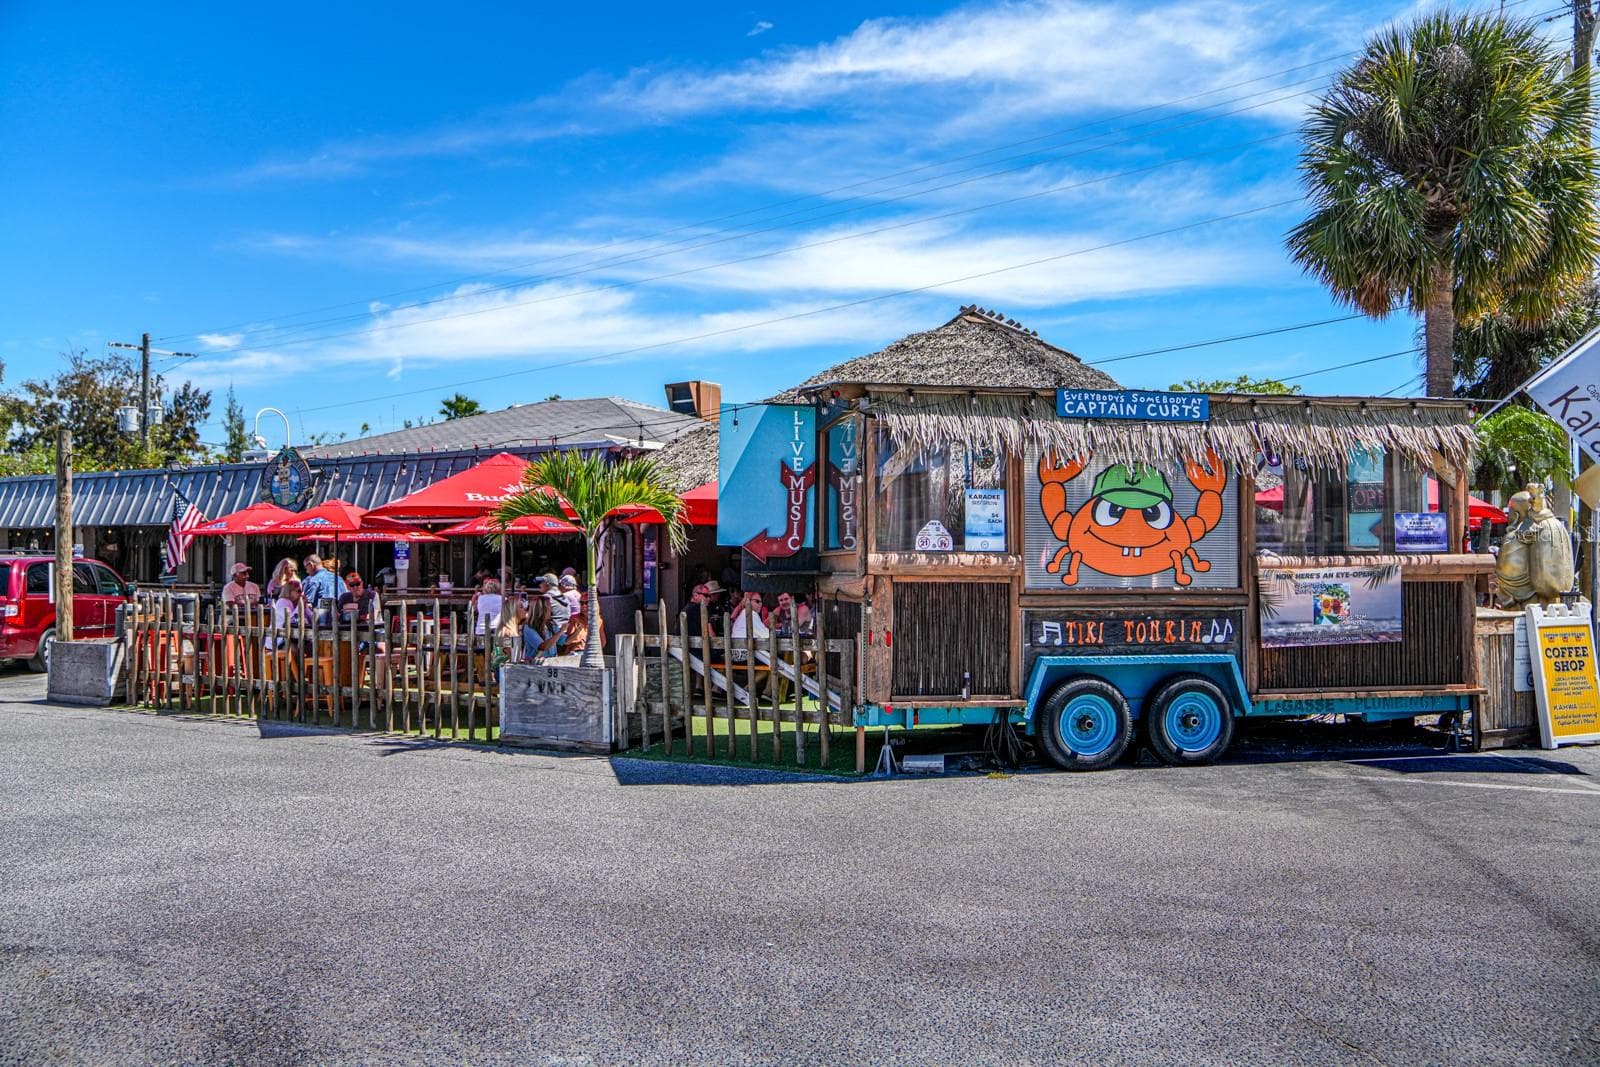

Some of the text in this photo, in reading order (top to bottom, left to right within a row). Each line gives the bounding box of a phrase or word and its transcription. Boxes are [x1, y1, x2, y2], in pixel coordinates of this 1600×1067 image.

[1131, 393, 1187, 405] SOMEBODY
[1064, 401, 1201, 419] CAPTAIN CURTS
[787, 410, 807, 551] LIVE MUSIC
[1295, 572, 1321, 580] HERE'S
[1066, 620, 1203, 645] TIKI TONKIN
[1544, 646, 1589, 658] COFFEE
[1554, 660, 1585, 672] SHOP
